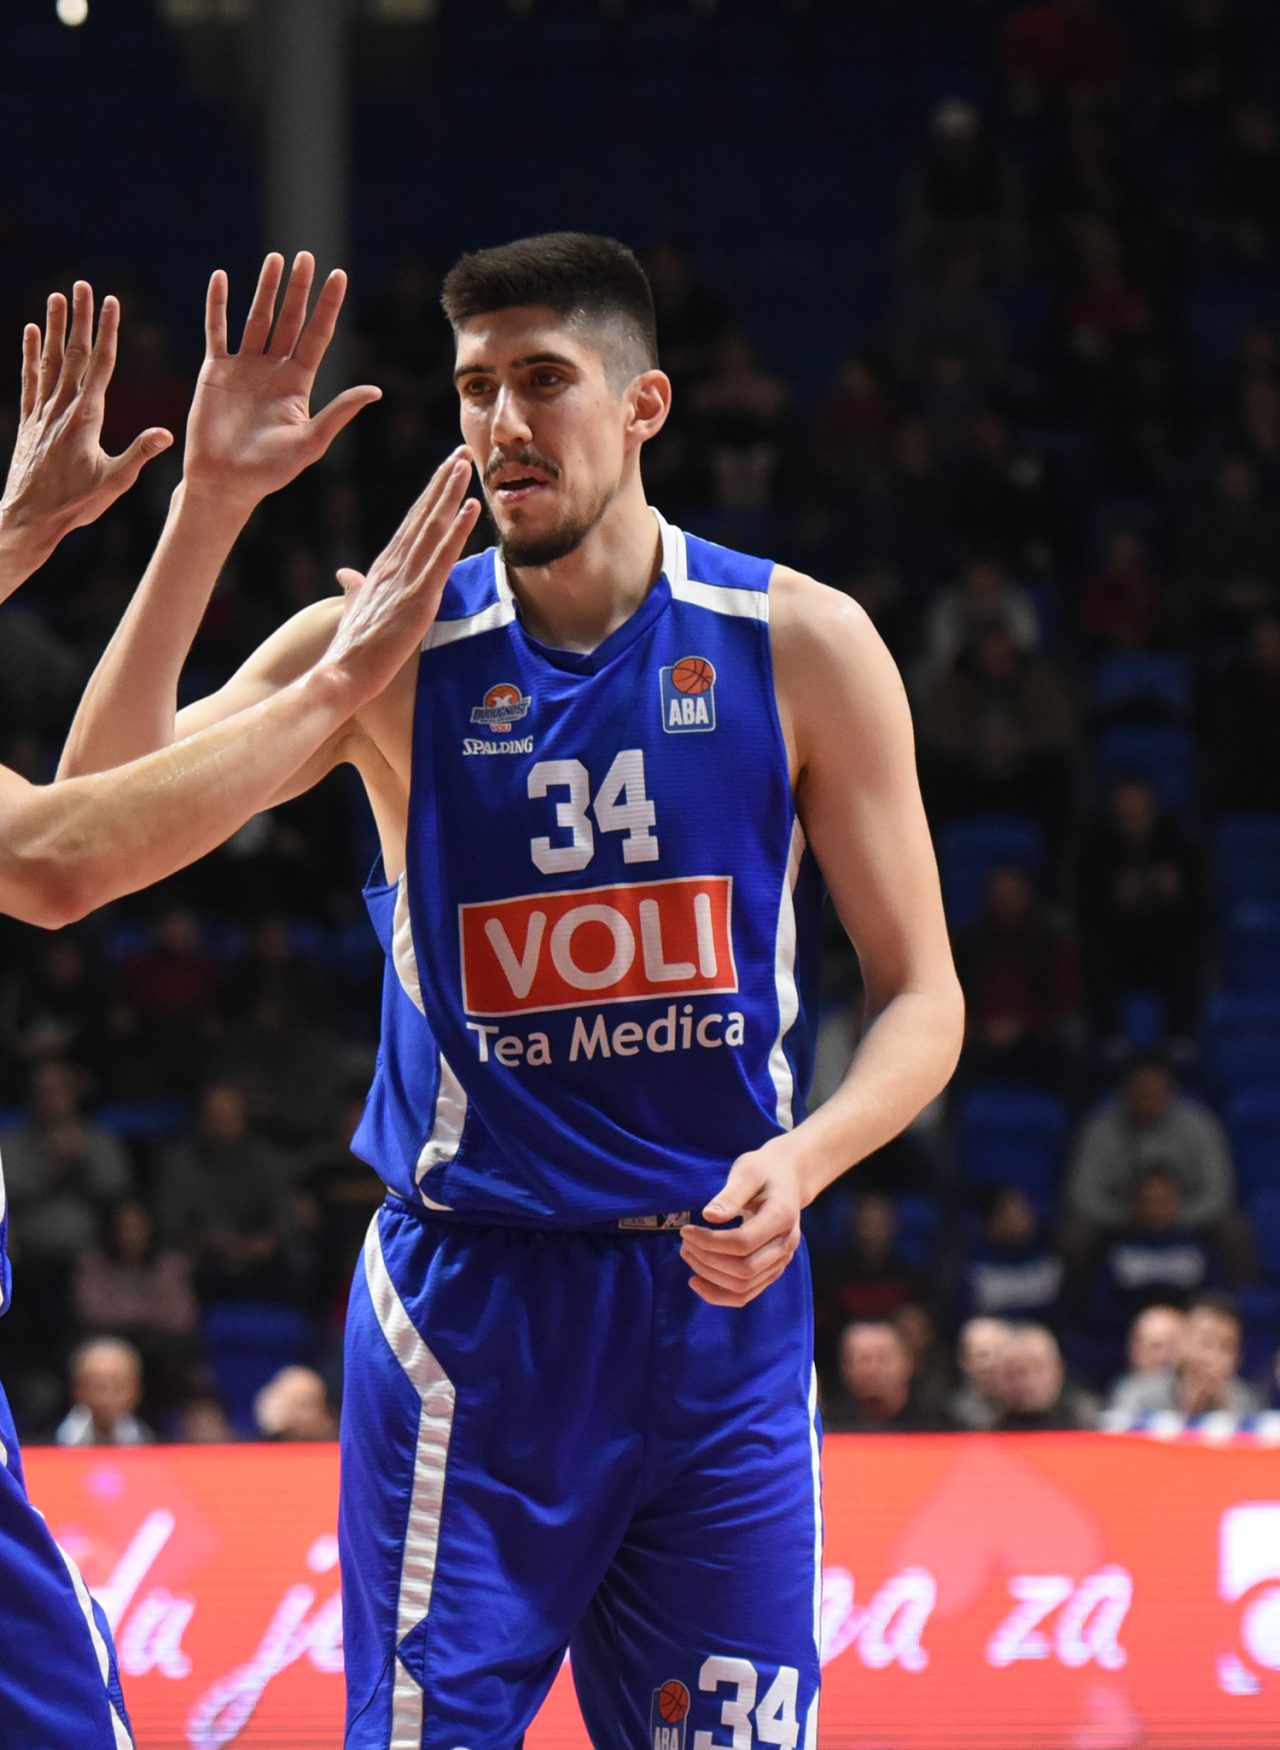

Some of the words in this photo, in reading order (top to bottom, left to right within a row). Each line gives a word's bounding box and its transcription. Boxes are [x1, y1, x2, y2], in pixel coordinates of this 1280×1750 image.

[462, 735, 534, 756] SPALDING
[669, 697, 710, 726] ABA
[527, 749, 660, 875] 34
[484, 893, 719, 999] VOLI
[466, 1022, 553, 1067] Tea
[569, 1004, 745, 1062] Medica
[985, 1564, 1134, 1671] za
[694, 1656, 800, 1750] 34
